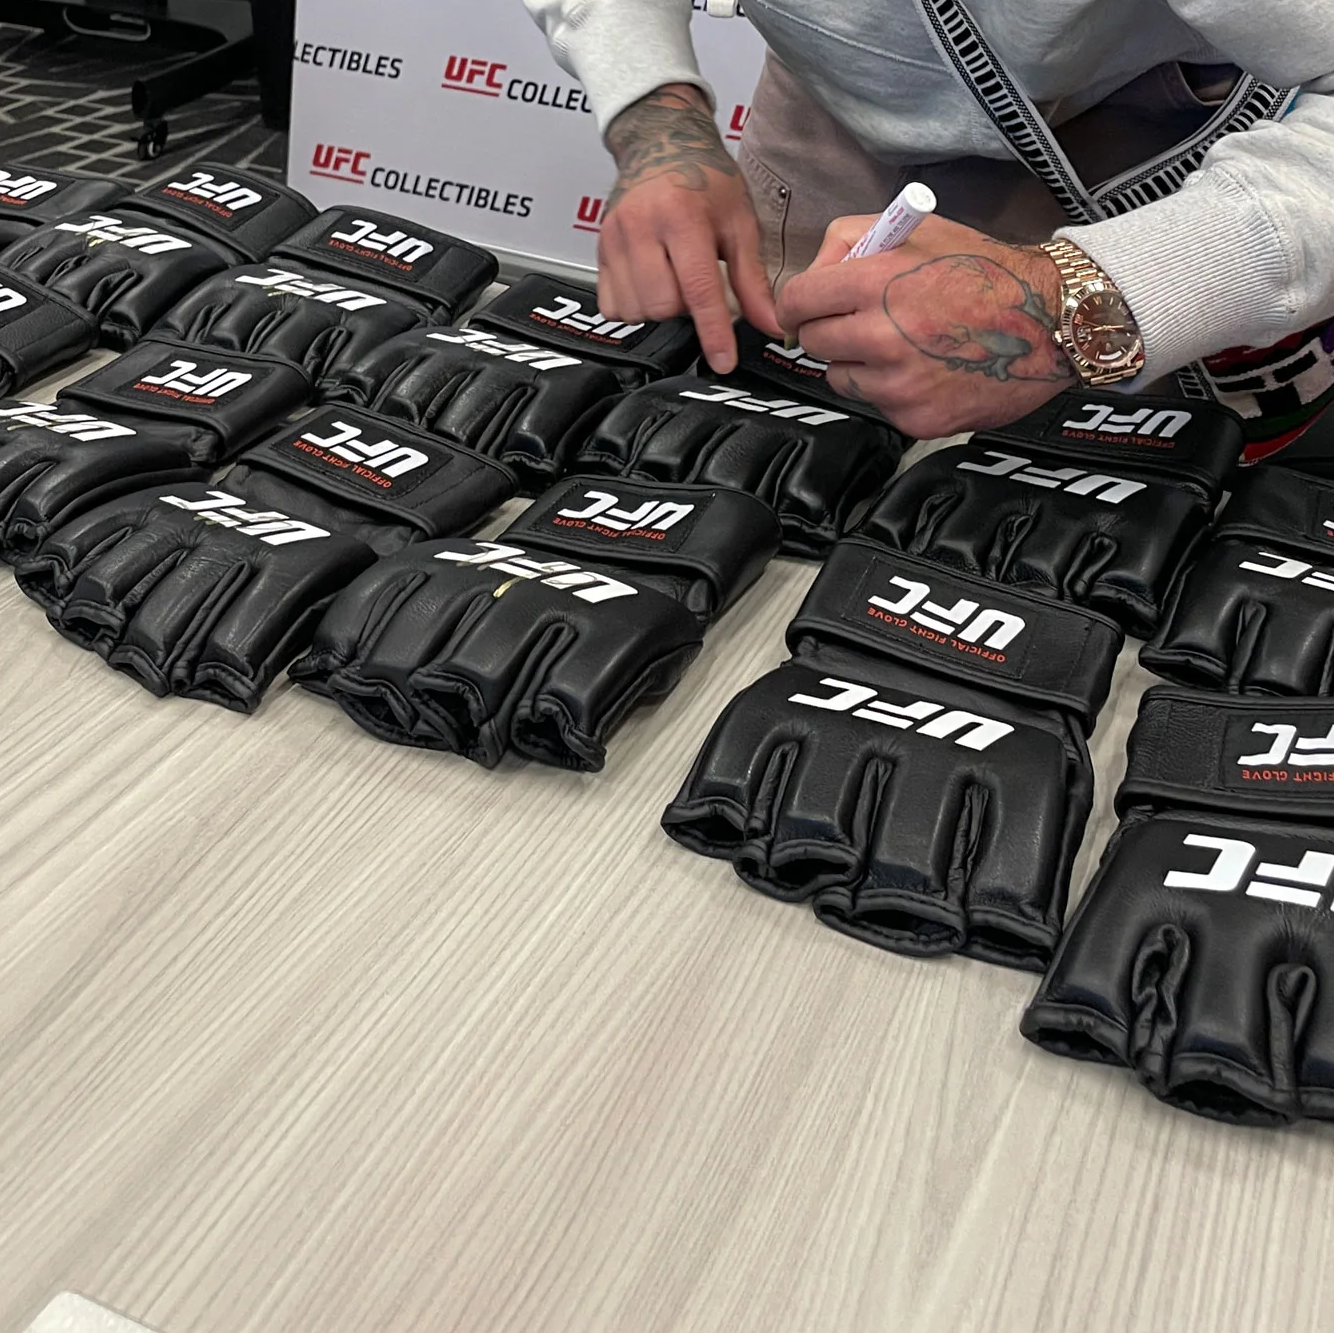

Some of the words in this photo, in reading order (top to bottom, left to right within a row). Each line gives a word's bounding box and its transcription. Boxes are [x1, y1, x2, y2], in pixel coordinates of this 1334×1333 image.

[444, 55, 507, 89] UFC
[168, 173, 262, 210] UFC
[312, 144, 371, 176] UFC
[370, 167, 534, 218] COLLECTIBLES
[54, 216, 192, 254] UFC
[331, 219, 434, 263] UFC
[235, 269, 387, 310] UFC
[427, 328, 582, 370] UFC
[141, 360, 252, 397] UFC
[679, 386, 849, 425] UFC
[1063, 405, 1191, 437] UFC
[293, 440, 323, 459] GLOVE
[301, 421, 428, 477] UFC
[323, 451, 349, 468] FIGHT
[353, 465, 392, 488] OFFICIAL
[958, 452, 1146, 503] UFC
[159, 491, 330, 545] UFC
[553, 517, 586, 528] GLOVE
[558, 491, 694, 530] UFC
[588, 525, 619, 538] FIGHT
[434, 543, 638, 603] UFC
[867, 607, 909, 628] GLOVE
[868, 576, 1025, 650] UFC
[910, 625, 947, 644] FIGHT
[951, 639, 1006, 662] OFFICIAL
[788, 678, 1014, 750] UFC
[1242, 768, 1289, 782] GLOVE
